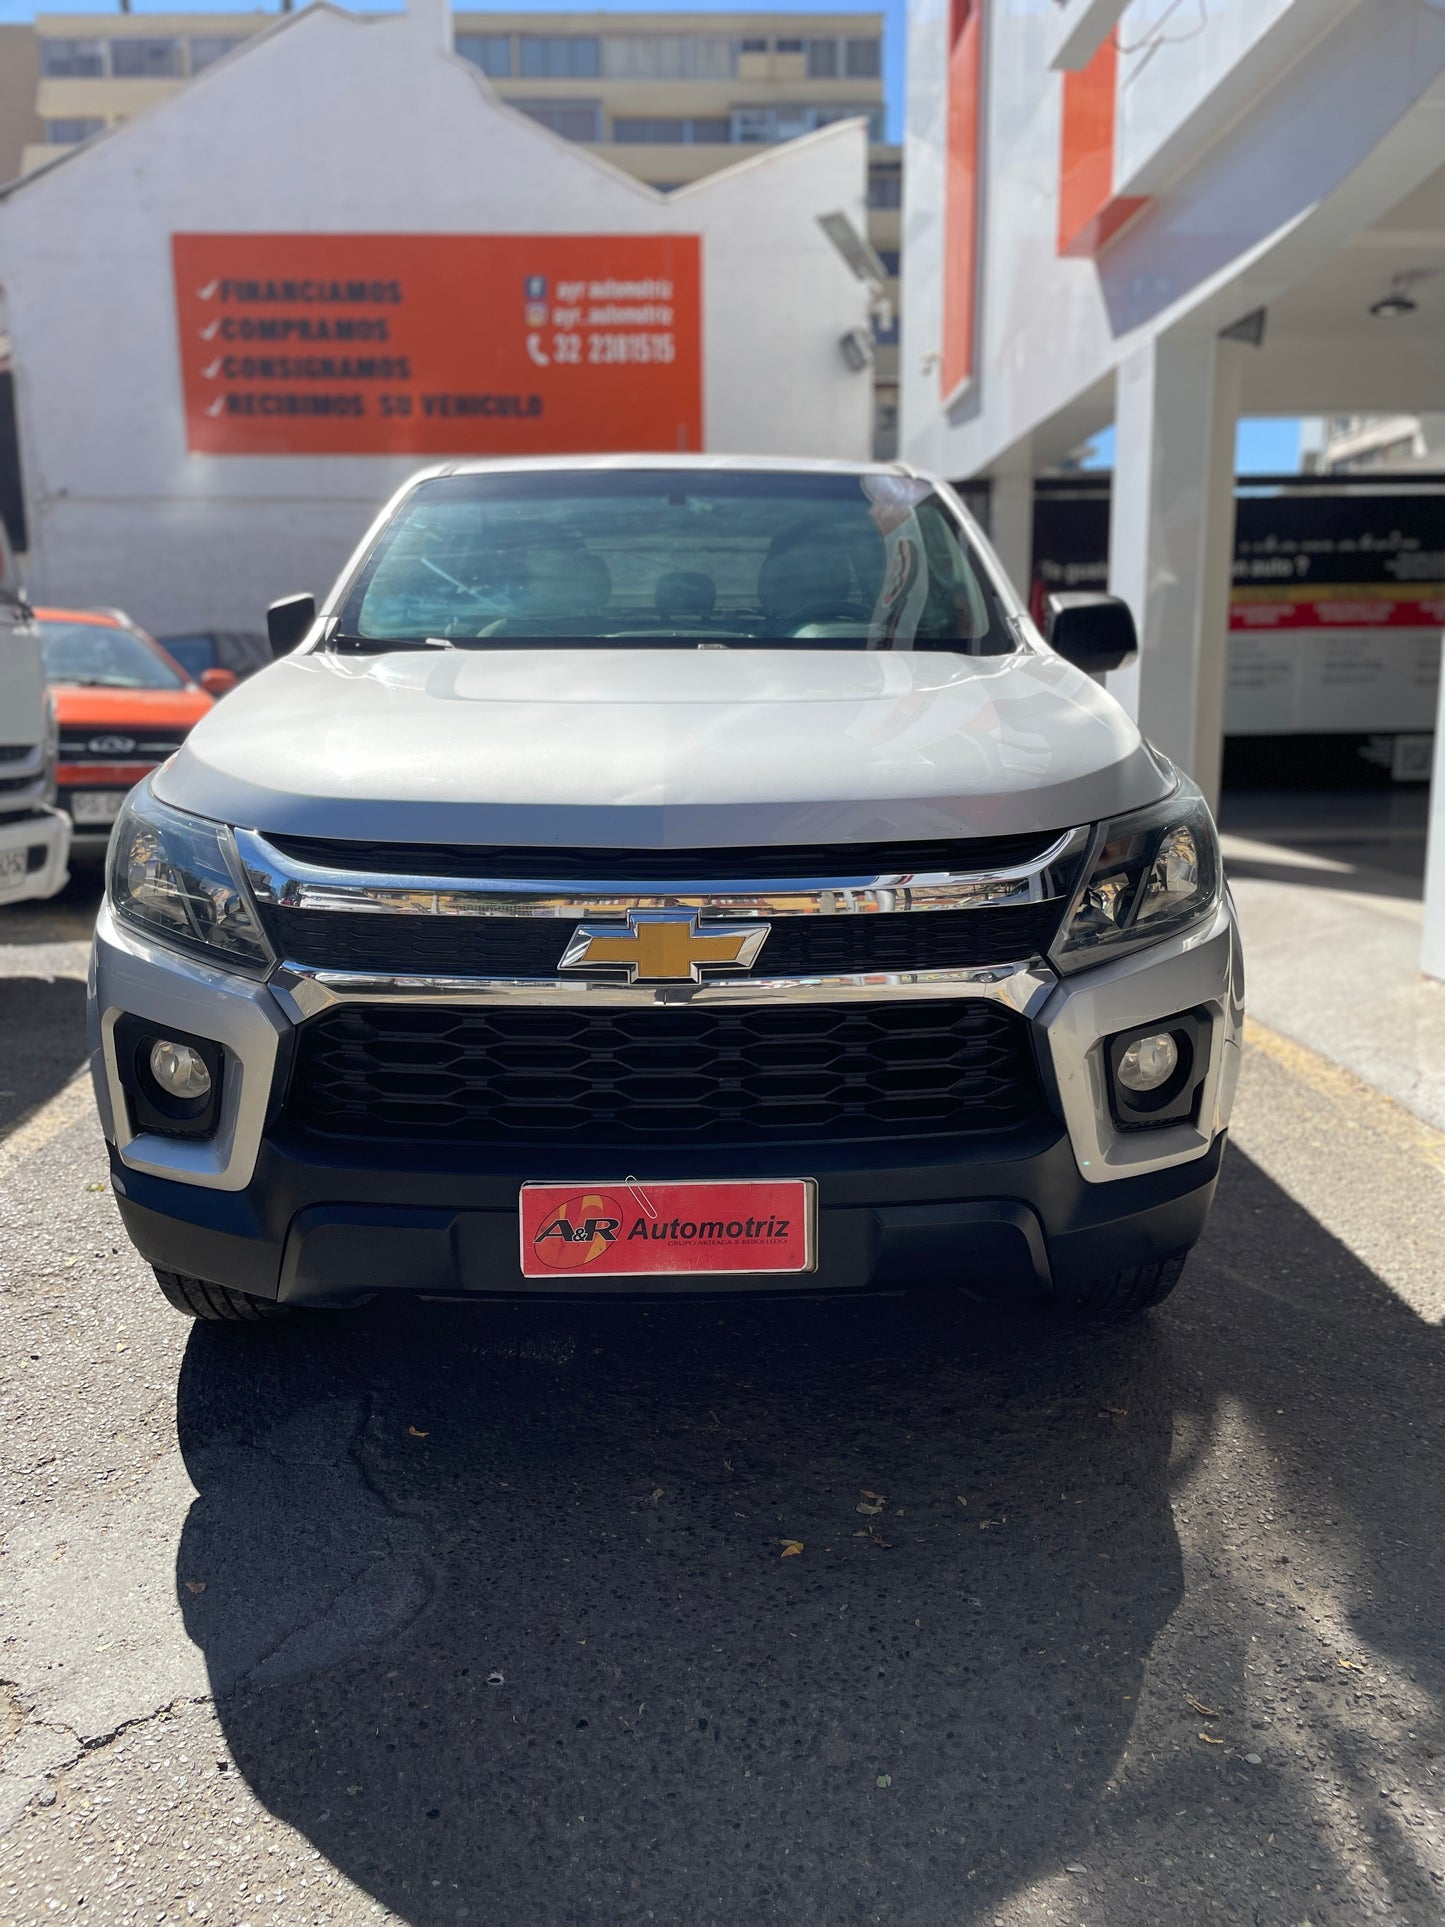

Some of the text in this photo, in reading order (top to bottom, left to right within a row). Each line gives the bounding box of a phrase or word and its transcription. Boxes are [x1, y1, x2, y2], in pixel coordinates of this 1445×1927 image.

[219, 280, 402, 304] FINANCIAMOS
[220, 317, 389, 342] COMPRAMOS
[552, 333, 582, 362] 32
[222, 355, 411, 380] CONSIGNAMOS
[225, 393, 366, 418] RECIBIMOS
[379, 393, 411, 417] SU
[532, 1215, 790, 1243] A&R Automotriz
